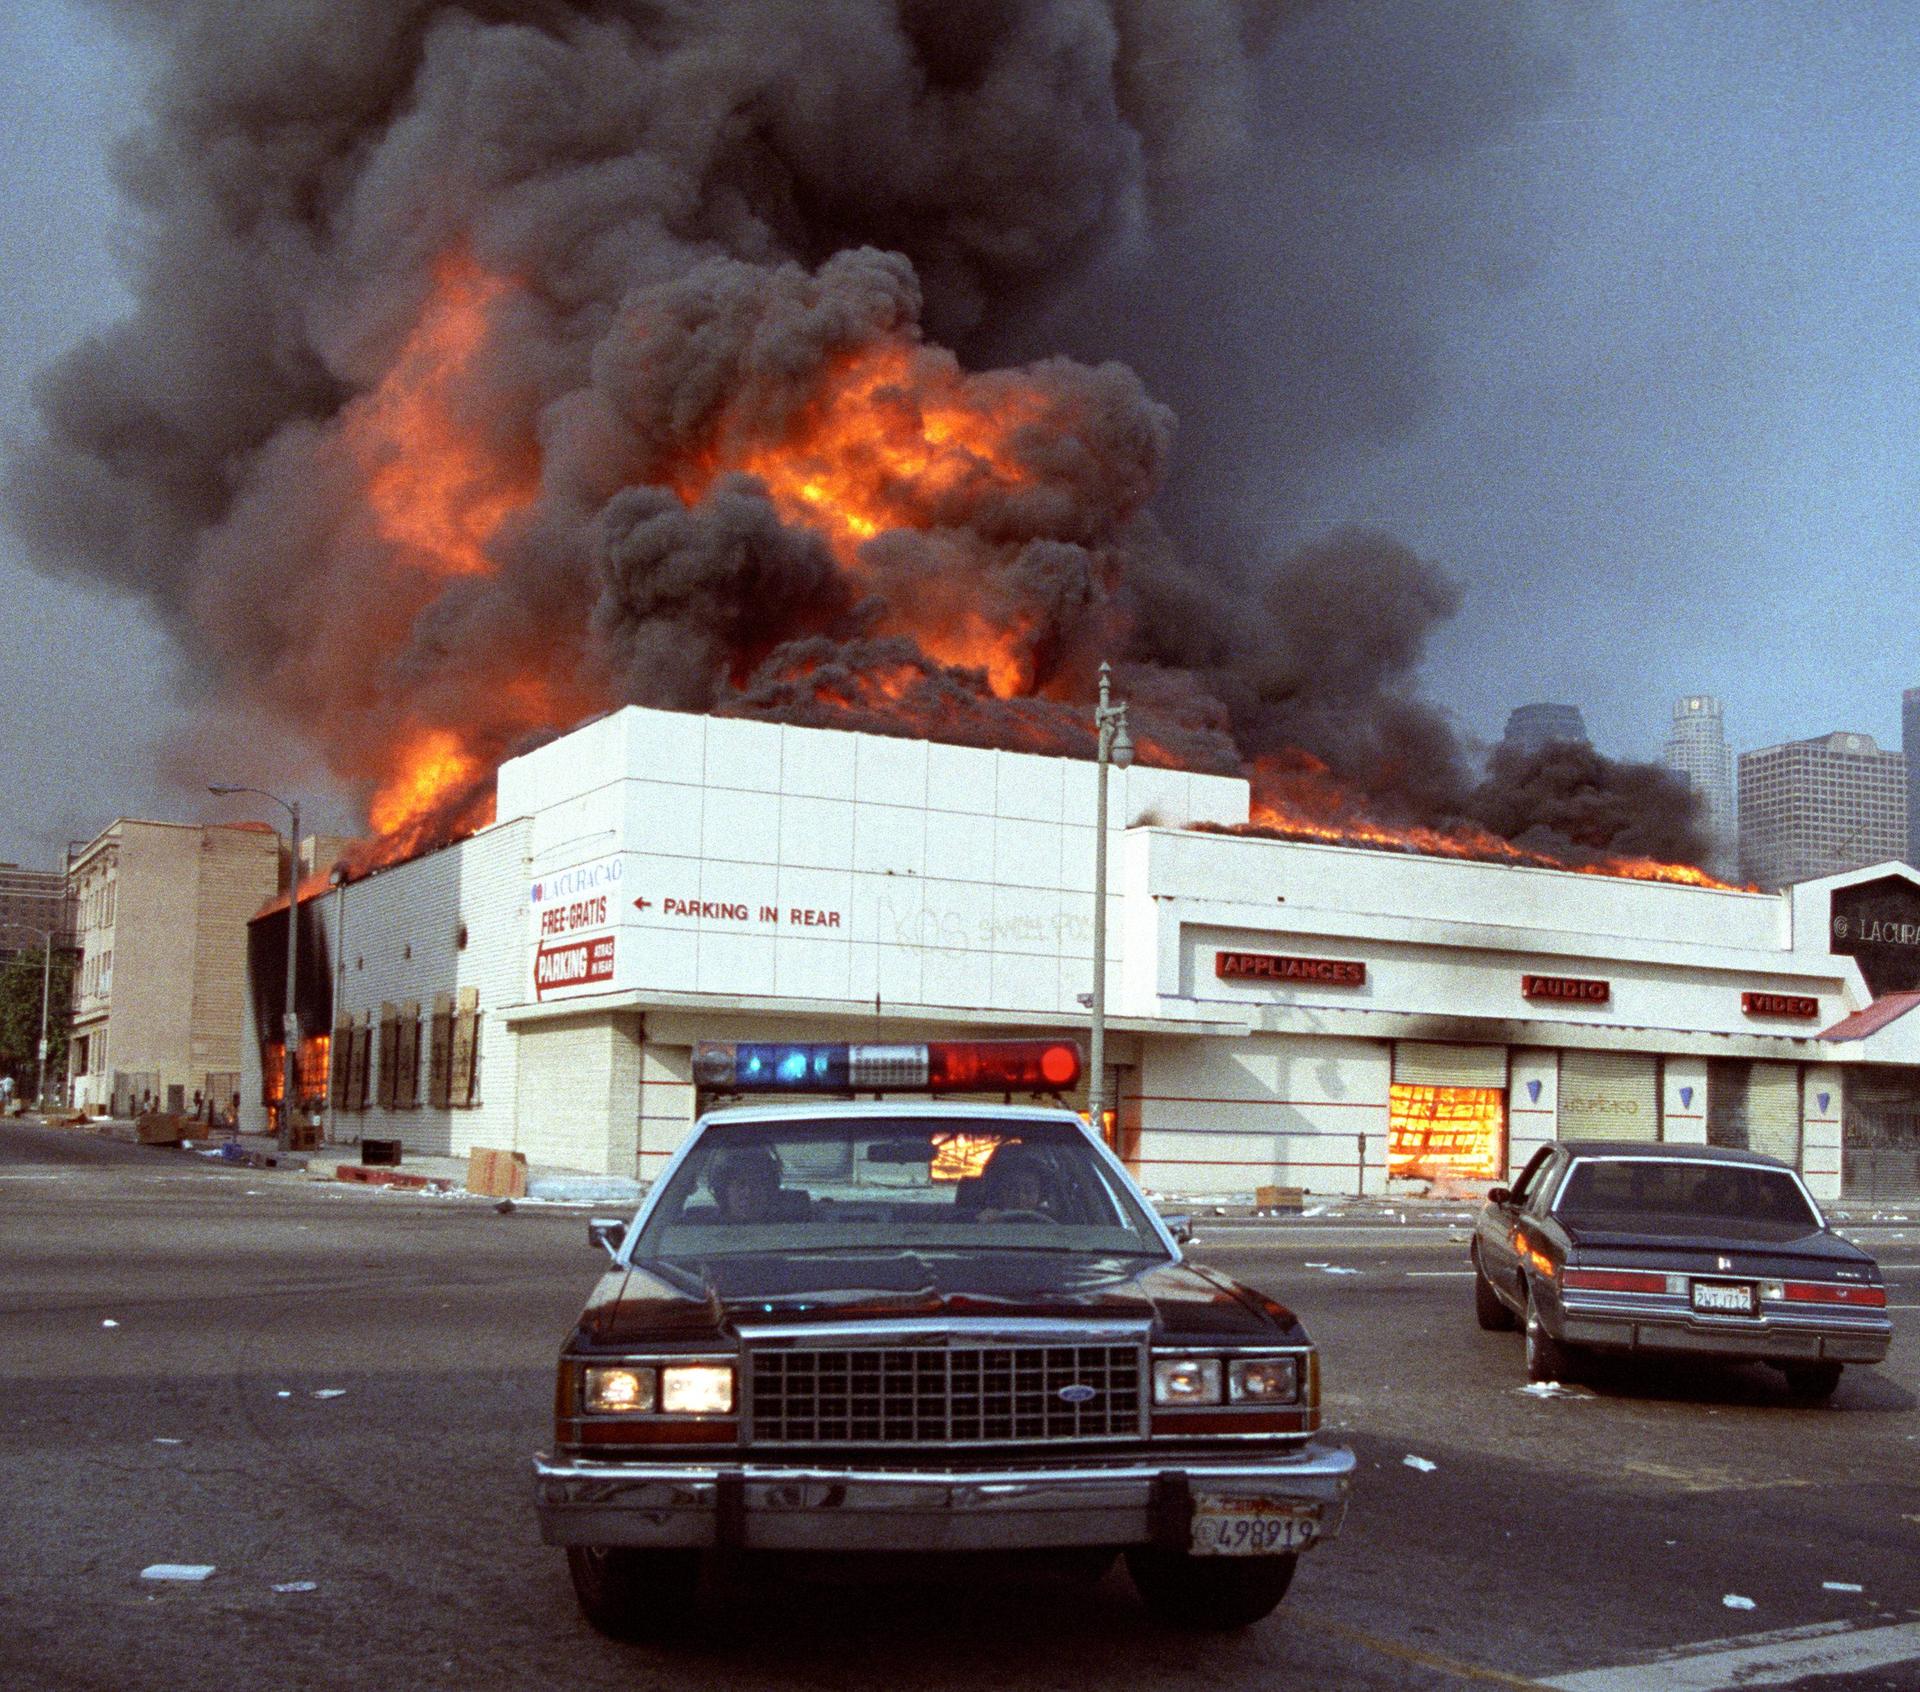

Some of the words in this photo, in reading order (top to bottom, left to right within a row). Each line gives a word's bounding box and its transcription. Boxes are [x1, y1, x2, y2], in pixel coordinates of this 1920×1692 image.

[664, 898, 748, 921] PARKING
[759, 907, 778, 923] IN
[791, 909, 840, 928] REAR
[538, 947, 588, 983] PARKING
[1225, 956, 1360, 980] APPLIANCES
[1532, 980, 1604, 999] AUDIO
[1751, 995, 1814, 1015] VIDEO
